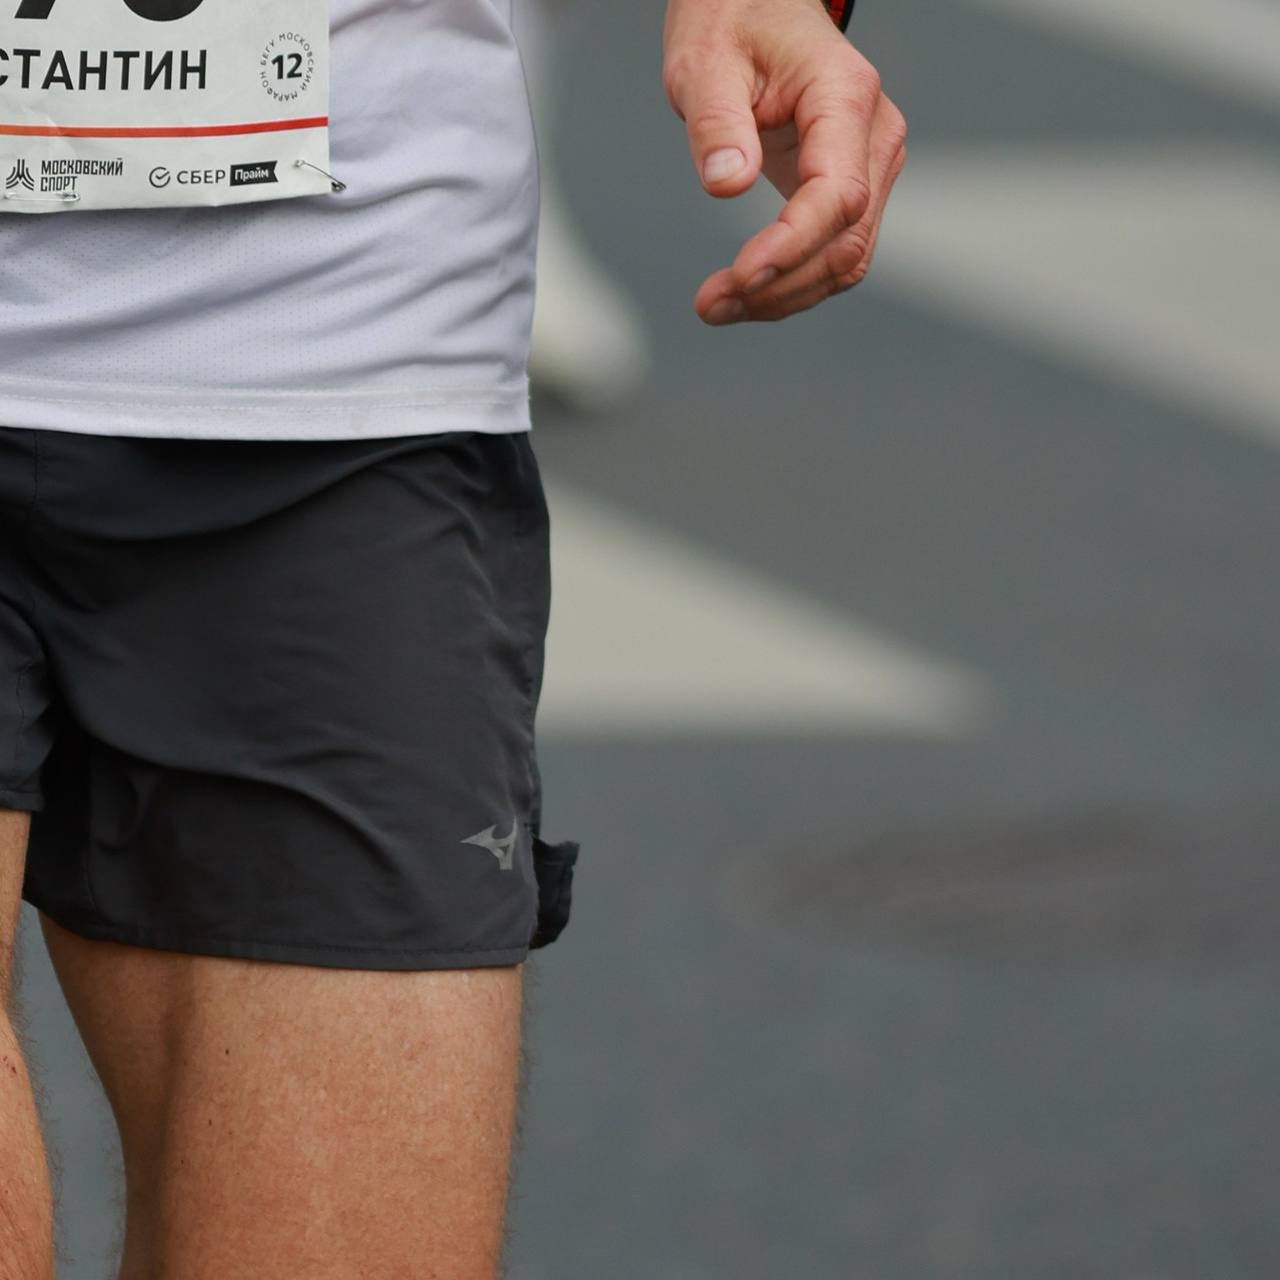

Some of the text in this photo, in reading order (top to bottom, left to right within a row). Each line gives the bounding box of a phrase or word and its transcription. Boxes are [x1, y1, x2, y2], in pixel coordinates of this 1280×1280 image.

[260, 32, 314, 102] БЕГУ МОСКОВСКИЙ МАРАФОН
[271, 52, 303, 80] 12
[40, 157, 124, 177] МОСКОВСКИЙ
[176, 166, 270, 185] СБЕР Прайм
[40, 176, 78, 192] СПОРТ
